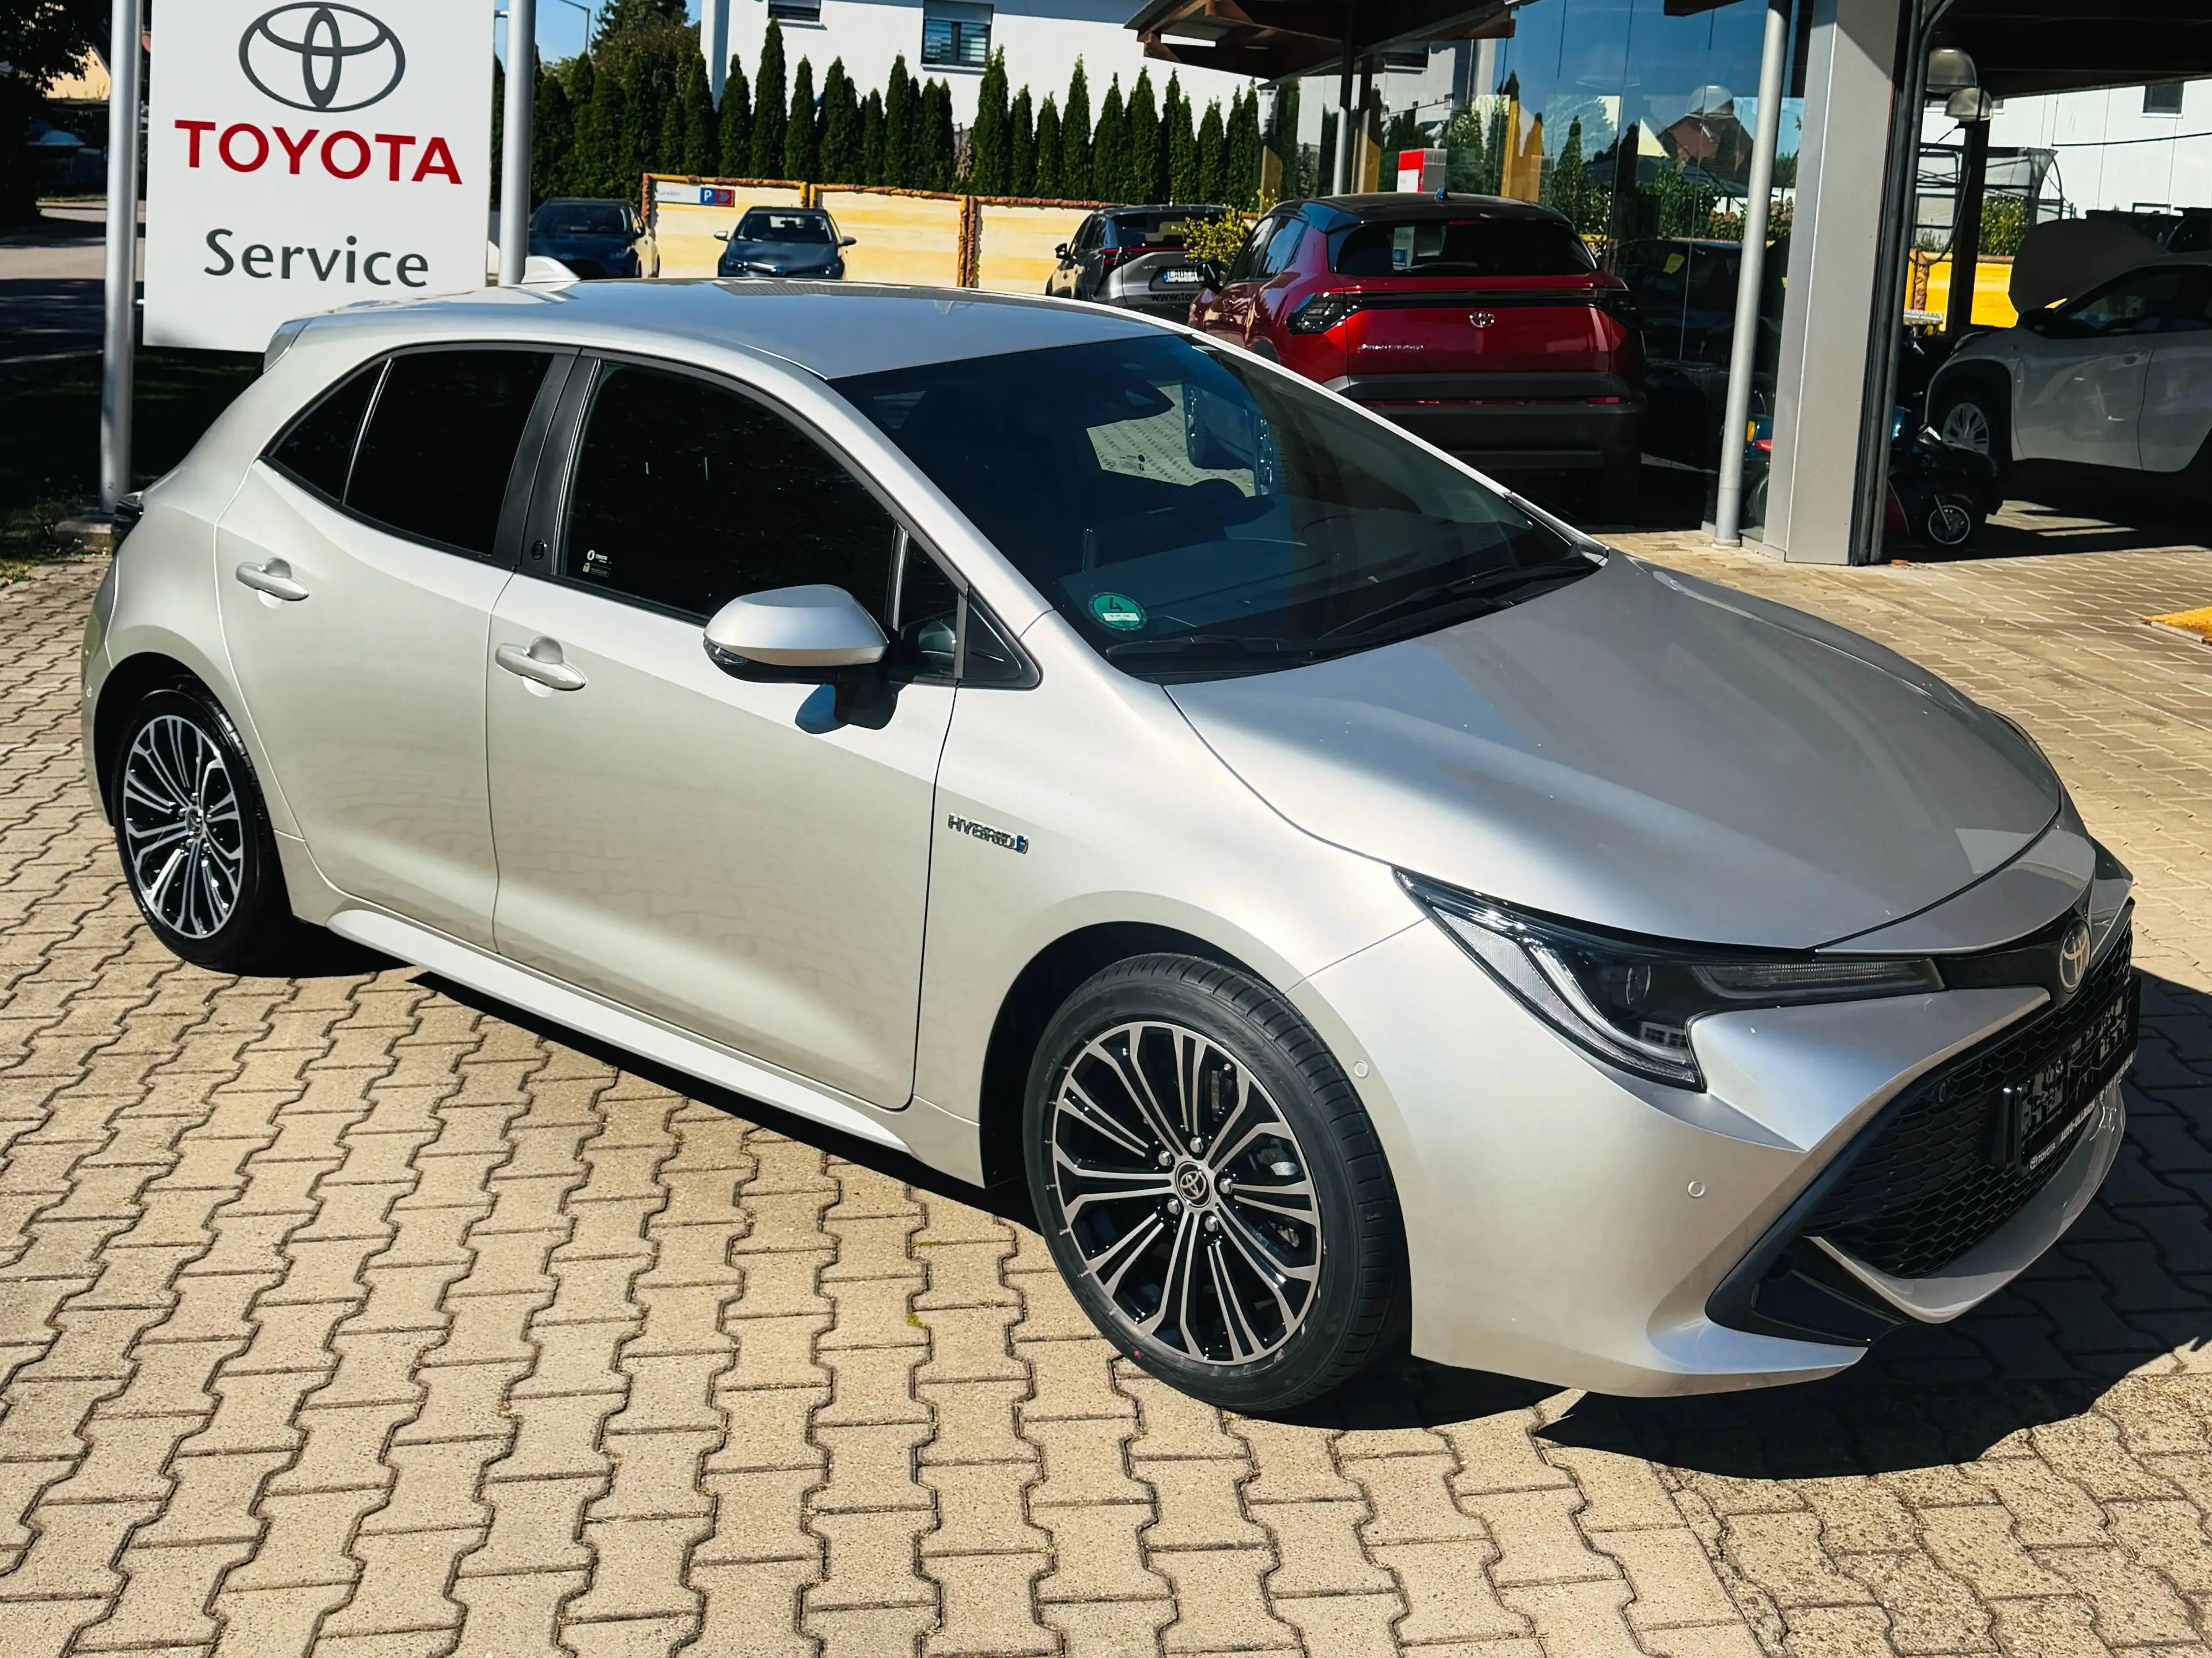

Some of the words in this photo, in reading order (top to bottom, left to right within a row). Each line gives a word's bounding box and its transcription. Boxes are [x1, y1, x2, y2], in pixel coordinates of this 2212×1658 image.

[175, 119, 463, 185] TOYOTA
[704, 189, 712, 201] P
[204, 229, 429, 288] Service
[948, 814, 1015, 850] HYBRID
[2037, 1143, 2056, 1163] TOYOTA
